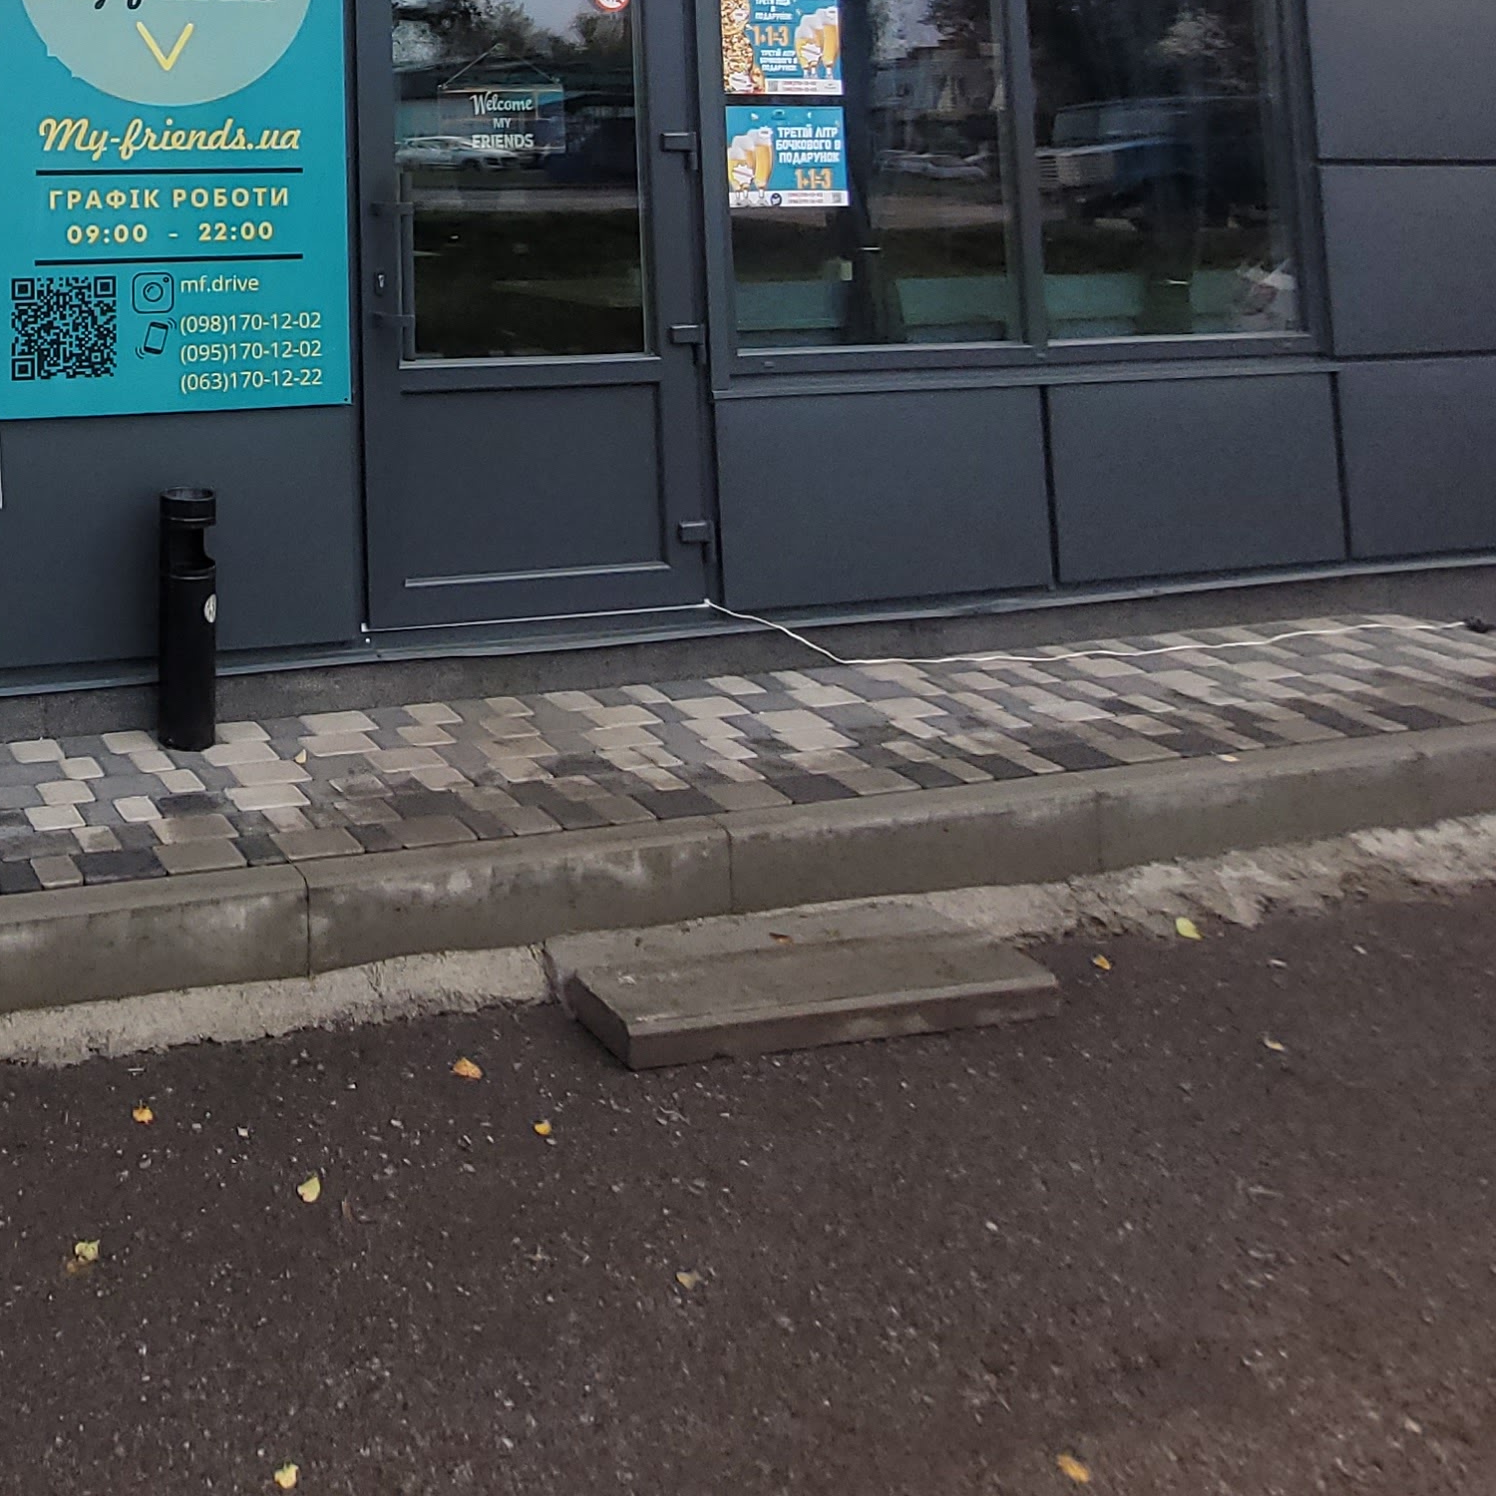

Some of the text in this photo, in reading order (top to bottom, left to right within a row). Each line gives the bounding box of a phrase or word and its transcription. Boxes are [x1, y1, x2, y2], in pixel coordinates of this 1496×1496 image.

[468, 90, 535, 116] Welcome
[492, 117, 512, 129] MY
[38, 117, 302, 162] My-friends.ua
[471, 133, 535, 149] FRIENDS
[778, 151, 841, 165] ПОДАРУНОК
[48, 186, 289, 211] ГРАФІК РОБОТИ
[66, 223, 149, 245] 09:00
[197, 221, 274, 242] 22:00
[180, 274, 260, 294] mf.drive
[179, 311, 322, 337] (098)170-12-02
[179, 340, 323, 366] (095)170-12-02
[180, 368, 324, 395] (063)170-12-22
